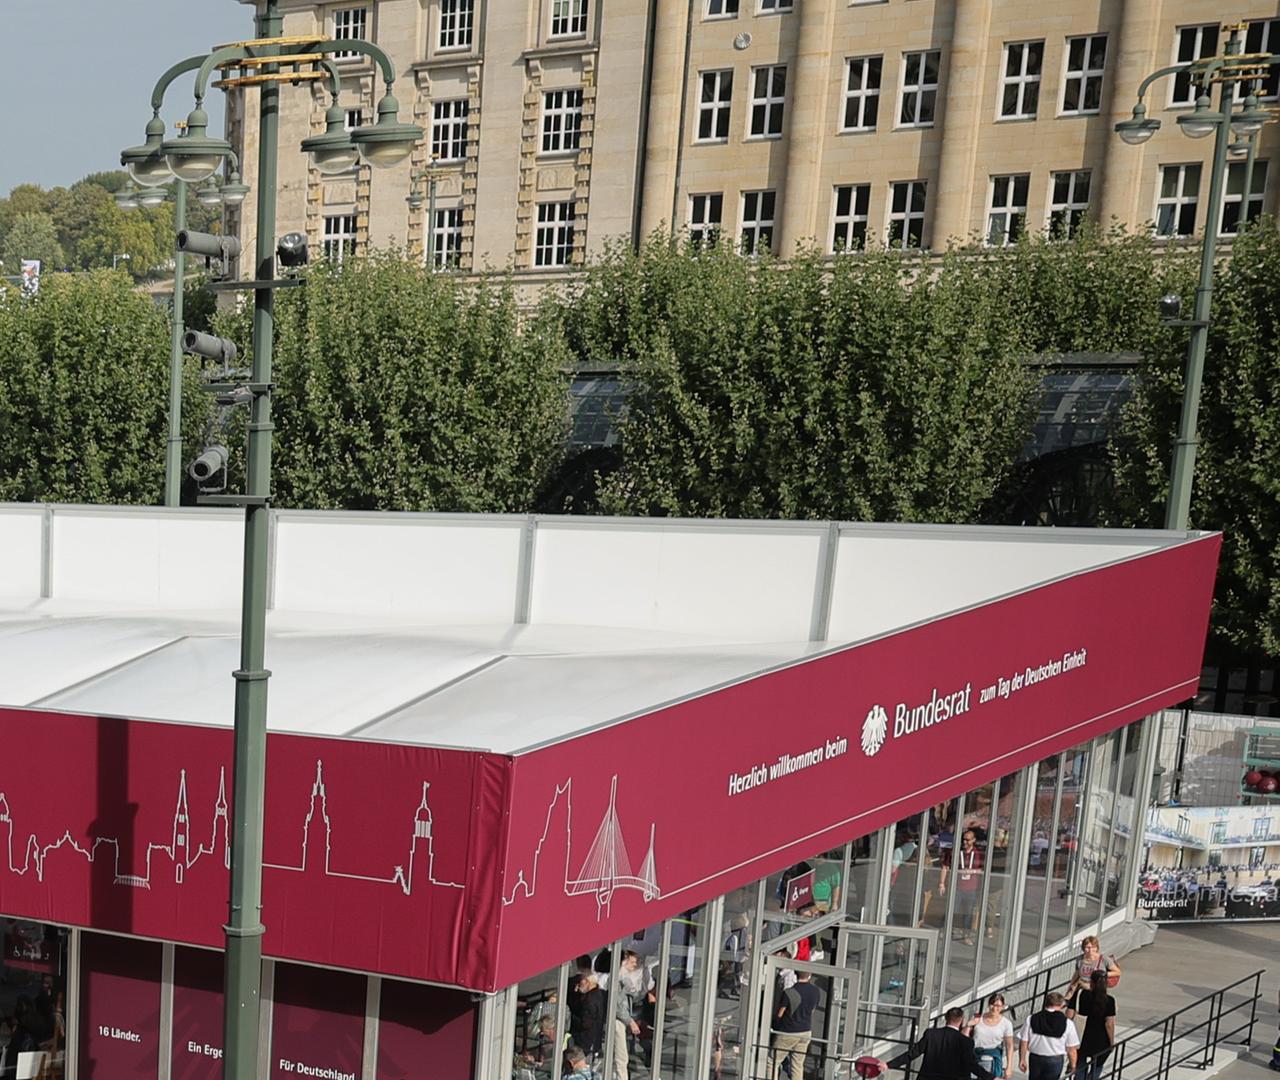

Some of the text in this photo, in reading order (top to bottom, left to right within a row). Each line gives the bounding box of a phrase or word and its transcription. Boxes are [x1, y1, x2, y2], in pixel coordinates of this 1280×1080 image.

[728, 648, 1087, 797] Herzlich willkommen beim Bundesrat zum Tag der Deutschen Einheit
[1137, 898, 1188, 908] Bundesrat
[98, 1025, 141, 1043] 16 Länder.
[188, 1041, 202, 1054] Ein
[279, 1058, 295, 1072] Für
